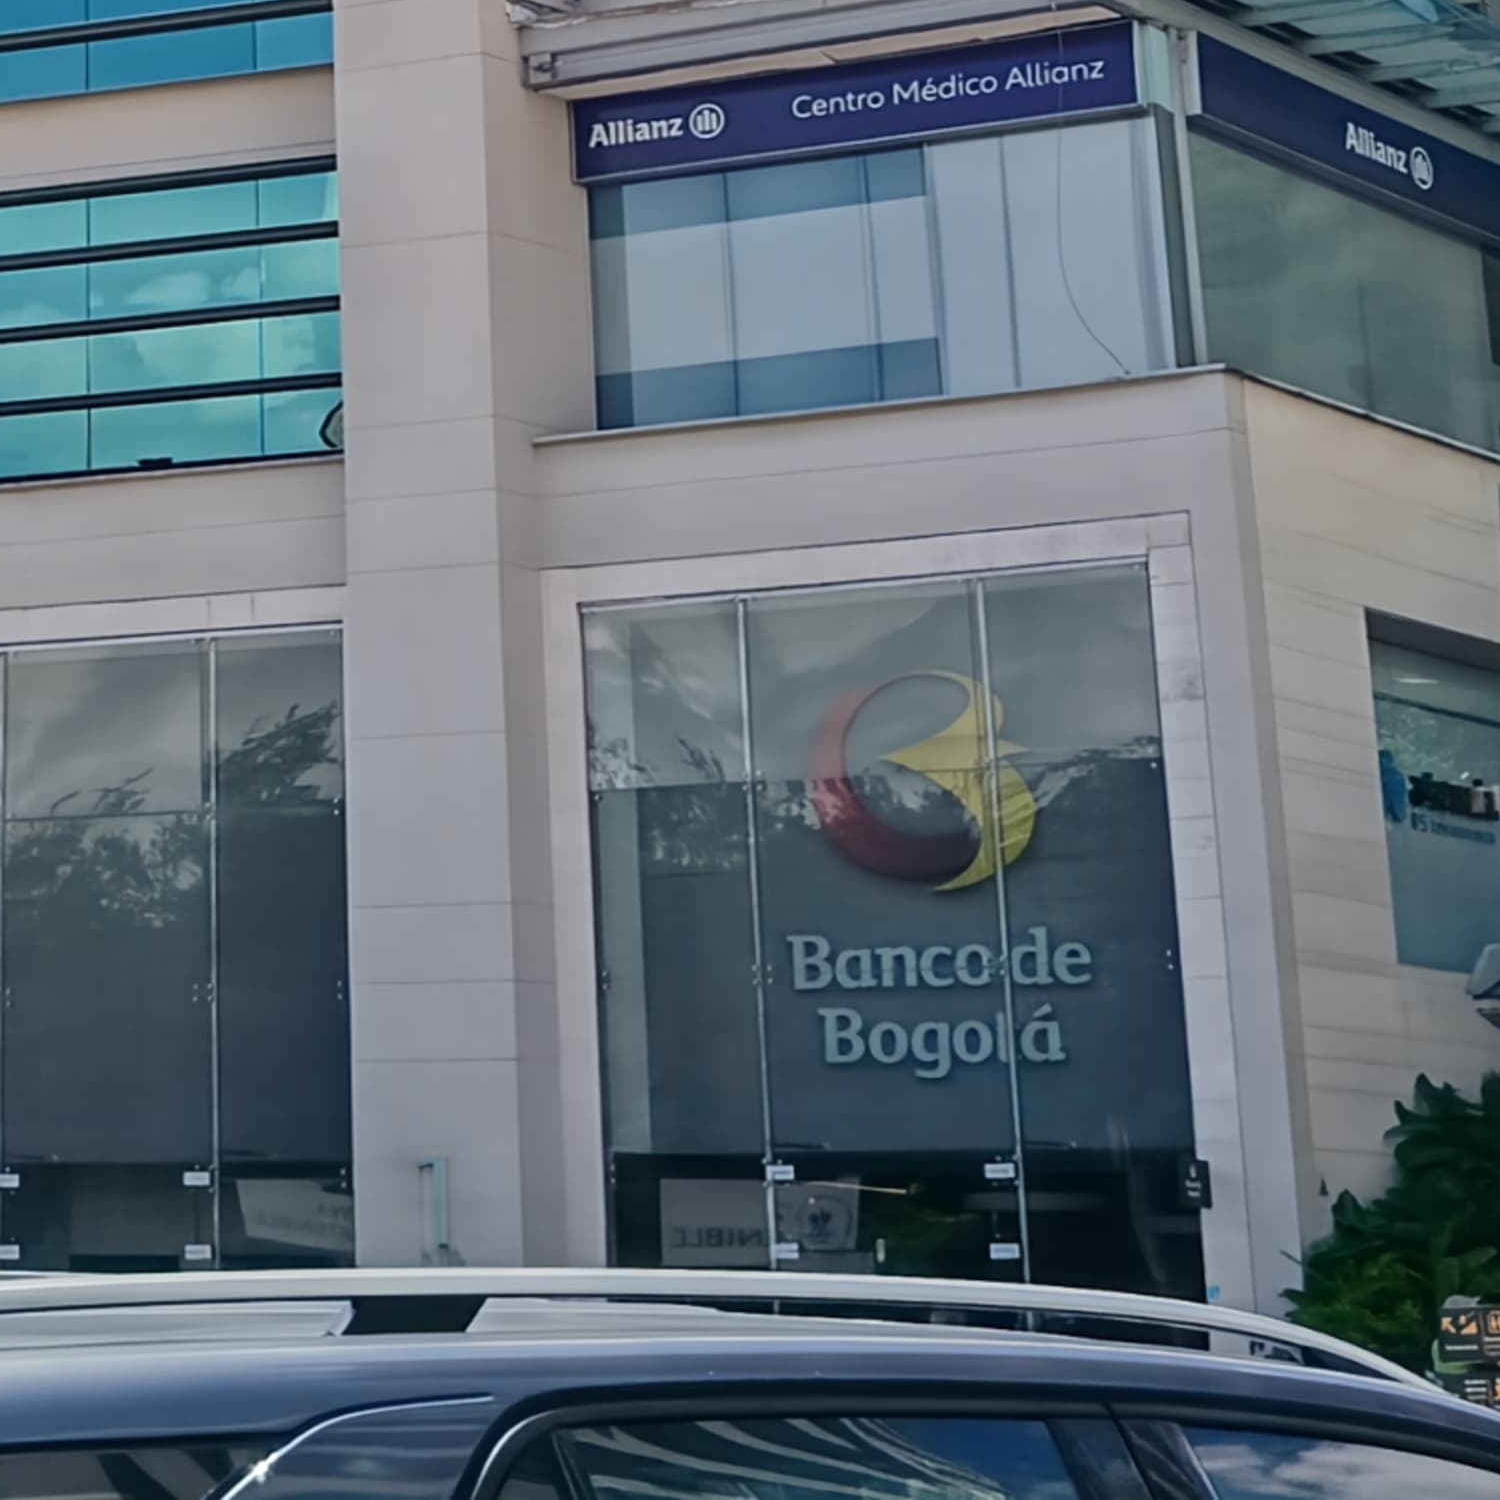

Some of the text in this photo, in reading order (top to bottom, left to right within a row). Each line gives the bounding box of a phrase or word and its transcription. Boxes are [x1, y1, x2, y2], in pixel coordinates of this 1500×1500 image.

[791, 59, 1105, 119] Centro Médico Allianz
[588, 117, 685, 148] Allianz
[1345, 121, 1408, 174] Allianz
[786, 925, 1093, 991] Banco de
